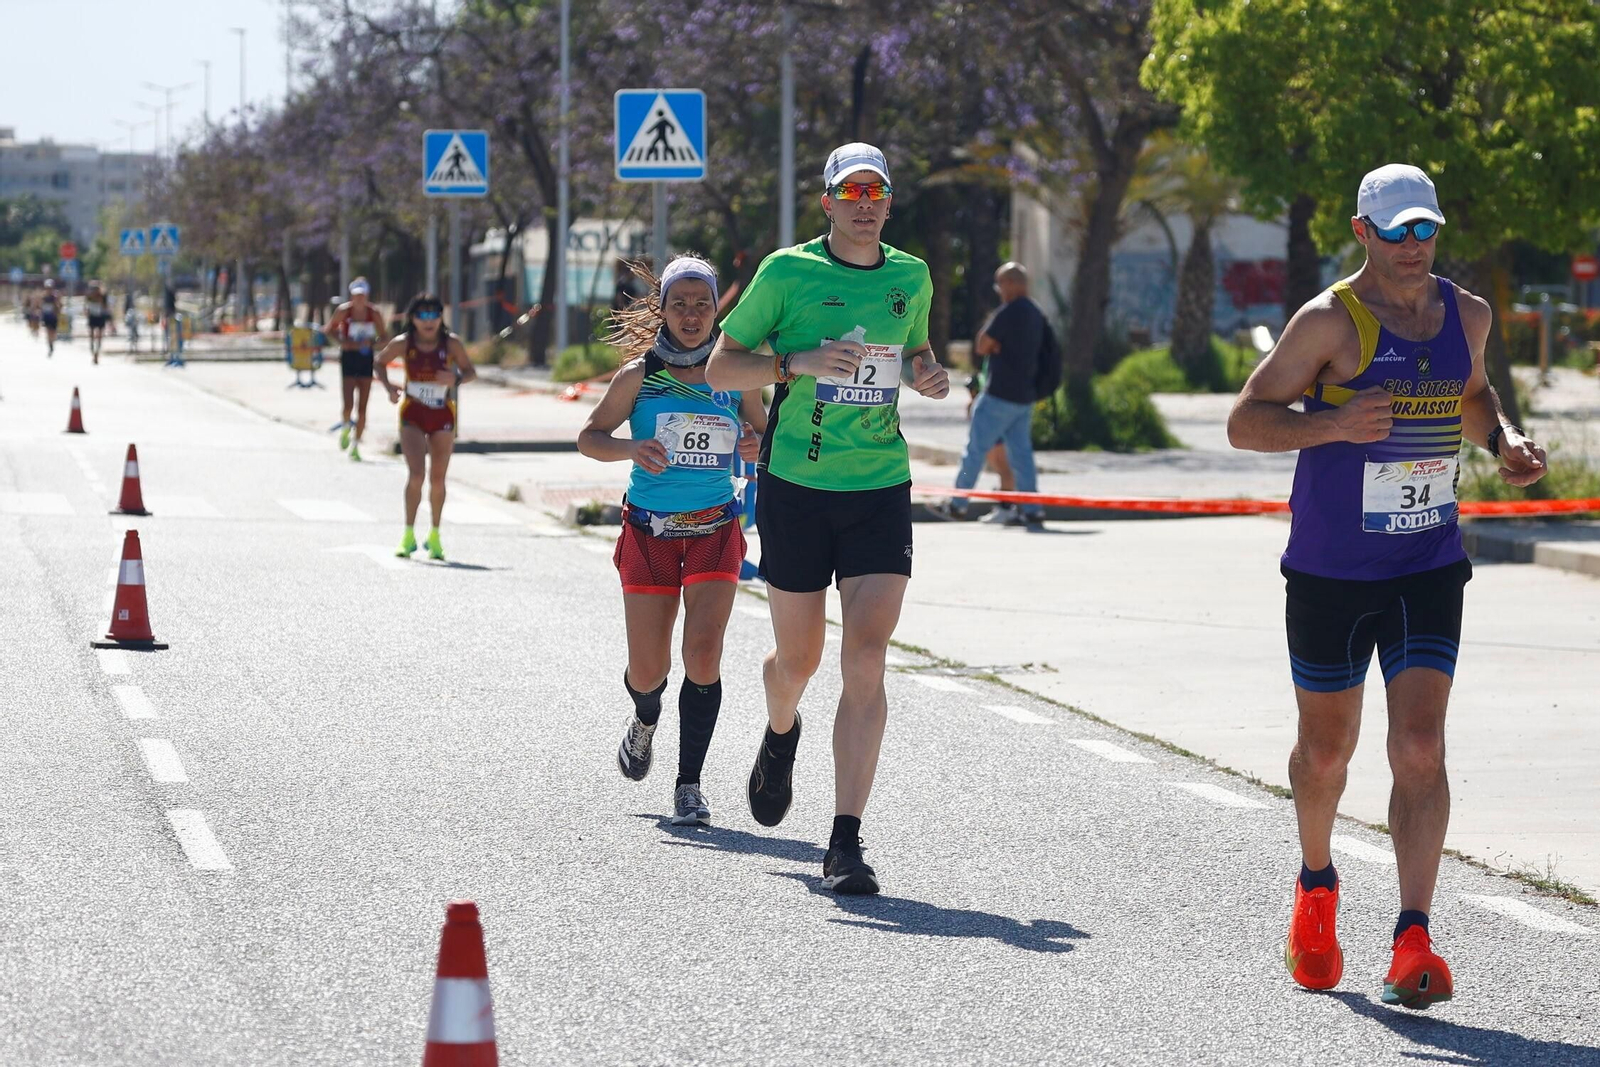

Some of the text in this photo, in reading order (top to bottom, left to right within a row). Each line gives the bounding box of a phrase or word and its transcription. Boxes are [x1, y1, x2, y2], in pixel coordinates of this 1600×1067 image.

[853, 365, 877, 385] 12
[1383, 379, 1463, 396] ELS SITGES
[1391, 400, 1459, 415] URJASSOT
[683, 432, 710, 450] 68
[1400, 483, 1431, 509] 34
